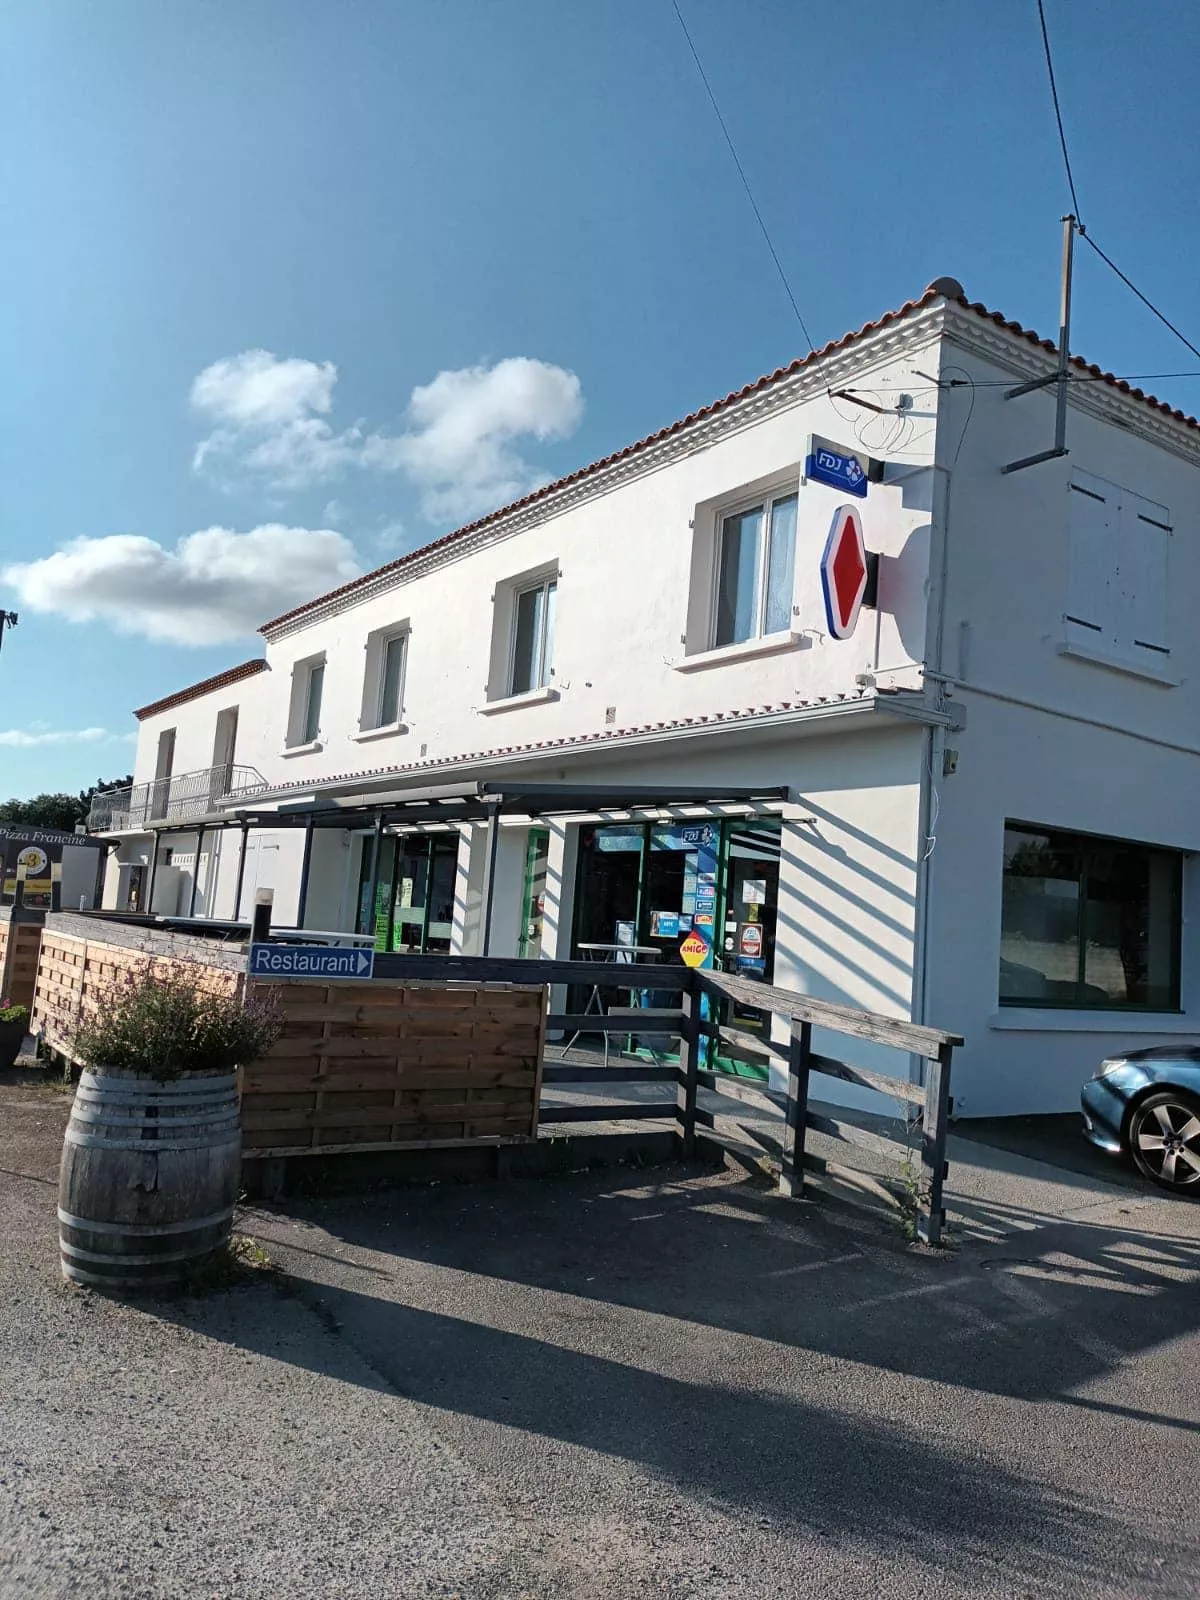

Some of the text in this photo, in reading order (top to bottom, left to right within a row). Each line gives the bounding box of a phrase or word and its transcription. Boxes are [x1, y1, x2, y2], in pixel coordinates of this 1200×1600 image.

[819, 452, 842, 471] FDJ
[0, 828, 86, 845] Pizza Francine
[683, 831, 700, 841] FDJ
[255, 949, 355, 972] Restaurant
